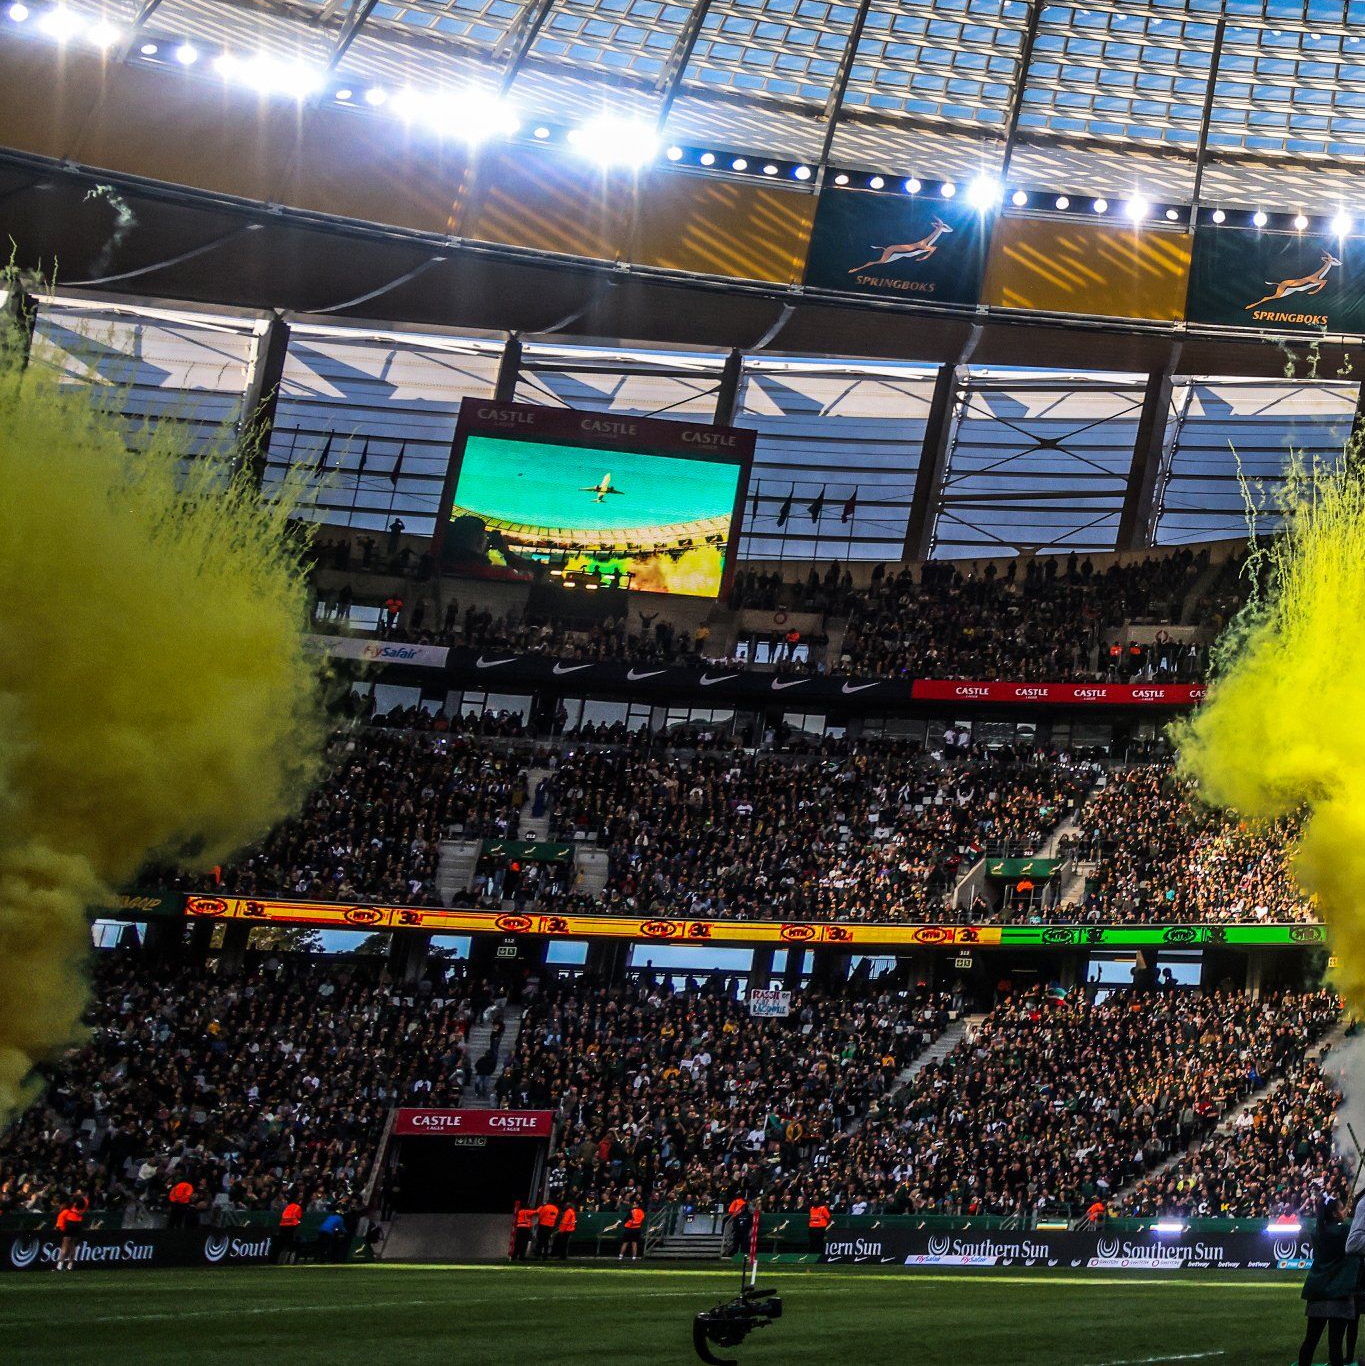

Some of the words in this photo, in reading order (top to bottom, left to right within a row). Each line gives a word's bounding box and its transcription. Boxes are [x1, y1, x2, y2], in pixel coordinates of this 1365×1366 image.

[855, 275, 936, 293] SPRINGBOKS
[1252, 311, 1329, 325] SPRINGBOKS
[477, 408, 535, 424] CASTLE
[580, 419, 637, 435] CASTLE
[681, 431, 737, 447] CASTLE
[955, 687, 989, 696] CASTLE
[1015, 688, 1048, 696] CASTLE
[1074, 689, 1107, 697] CASTLE
[1132, 690, 1165, 698] CASTLE
[411, 1115, 462, 1126] CASTLE
[488, 1116, 537, 1127] CASTLE
[40, 1240, 120, 1262] Sothern
[122, 1240, 154, 1261] Sun
[854, 1238, 882, 1255] Sun
[953, 1239, 1020, 1258] Southern
[1021, 1240, 1049, 1258] Sun
[1122, 1240, 1193, 1260] Southern
[1194, 1241, 1224, 1260] Sun
[1187, 1261, 1210, 1269] betway
[1217, 1261, 1240, 1269] betway
[1247, 1260, 1271, 1269] betway
